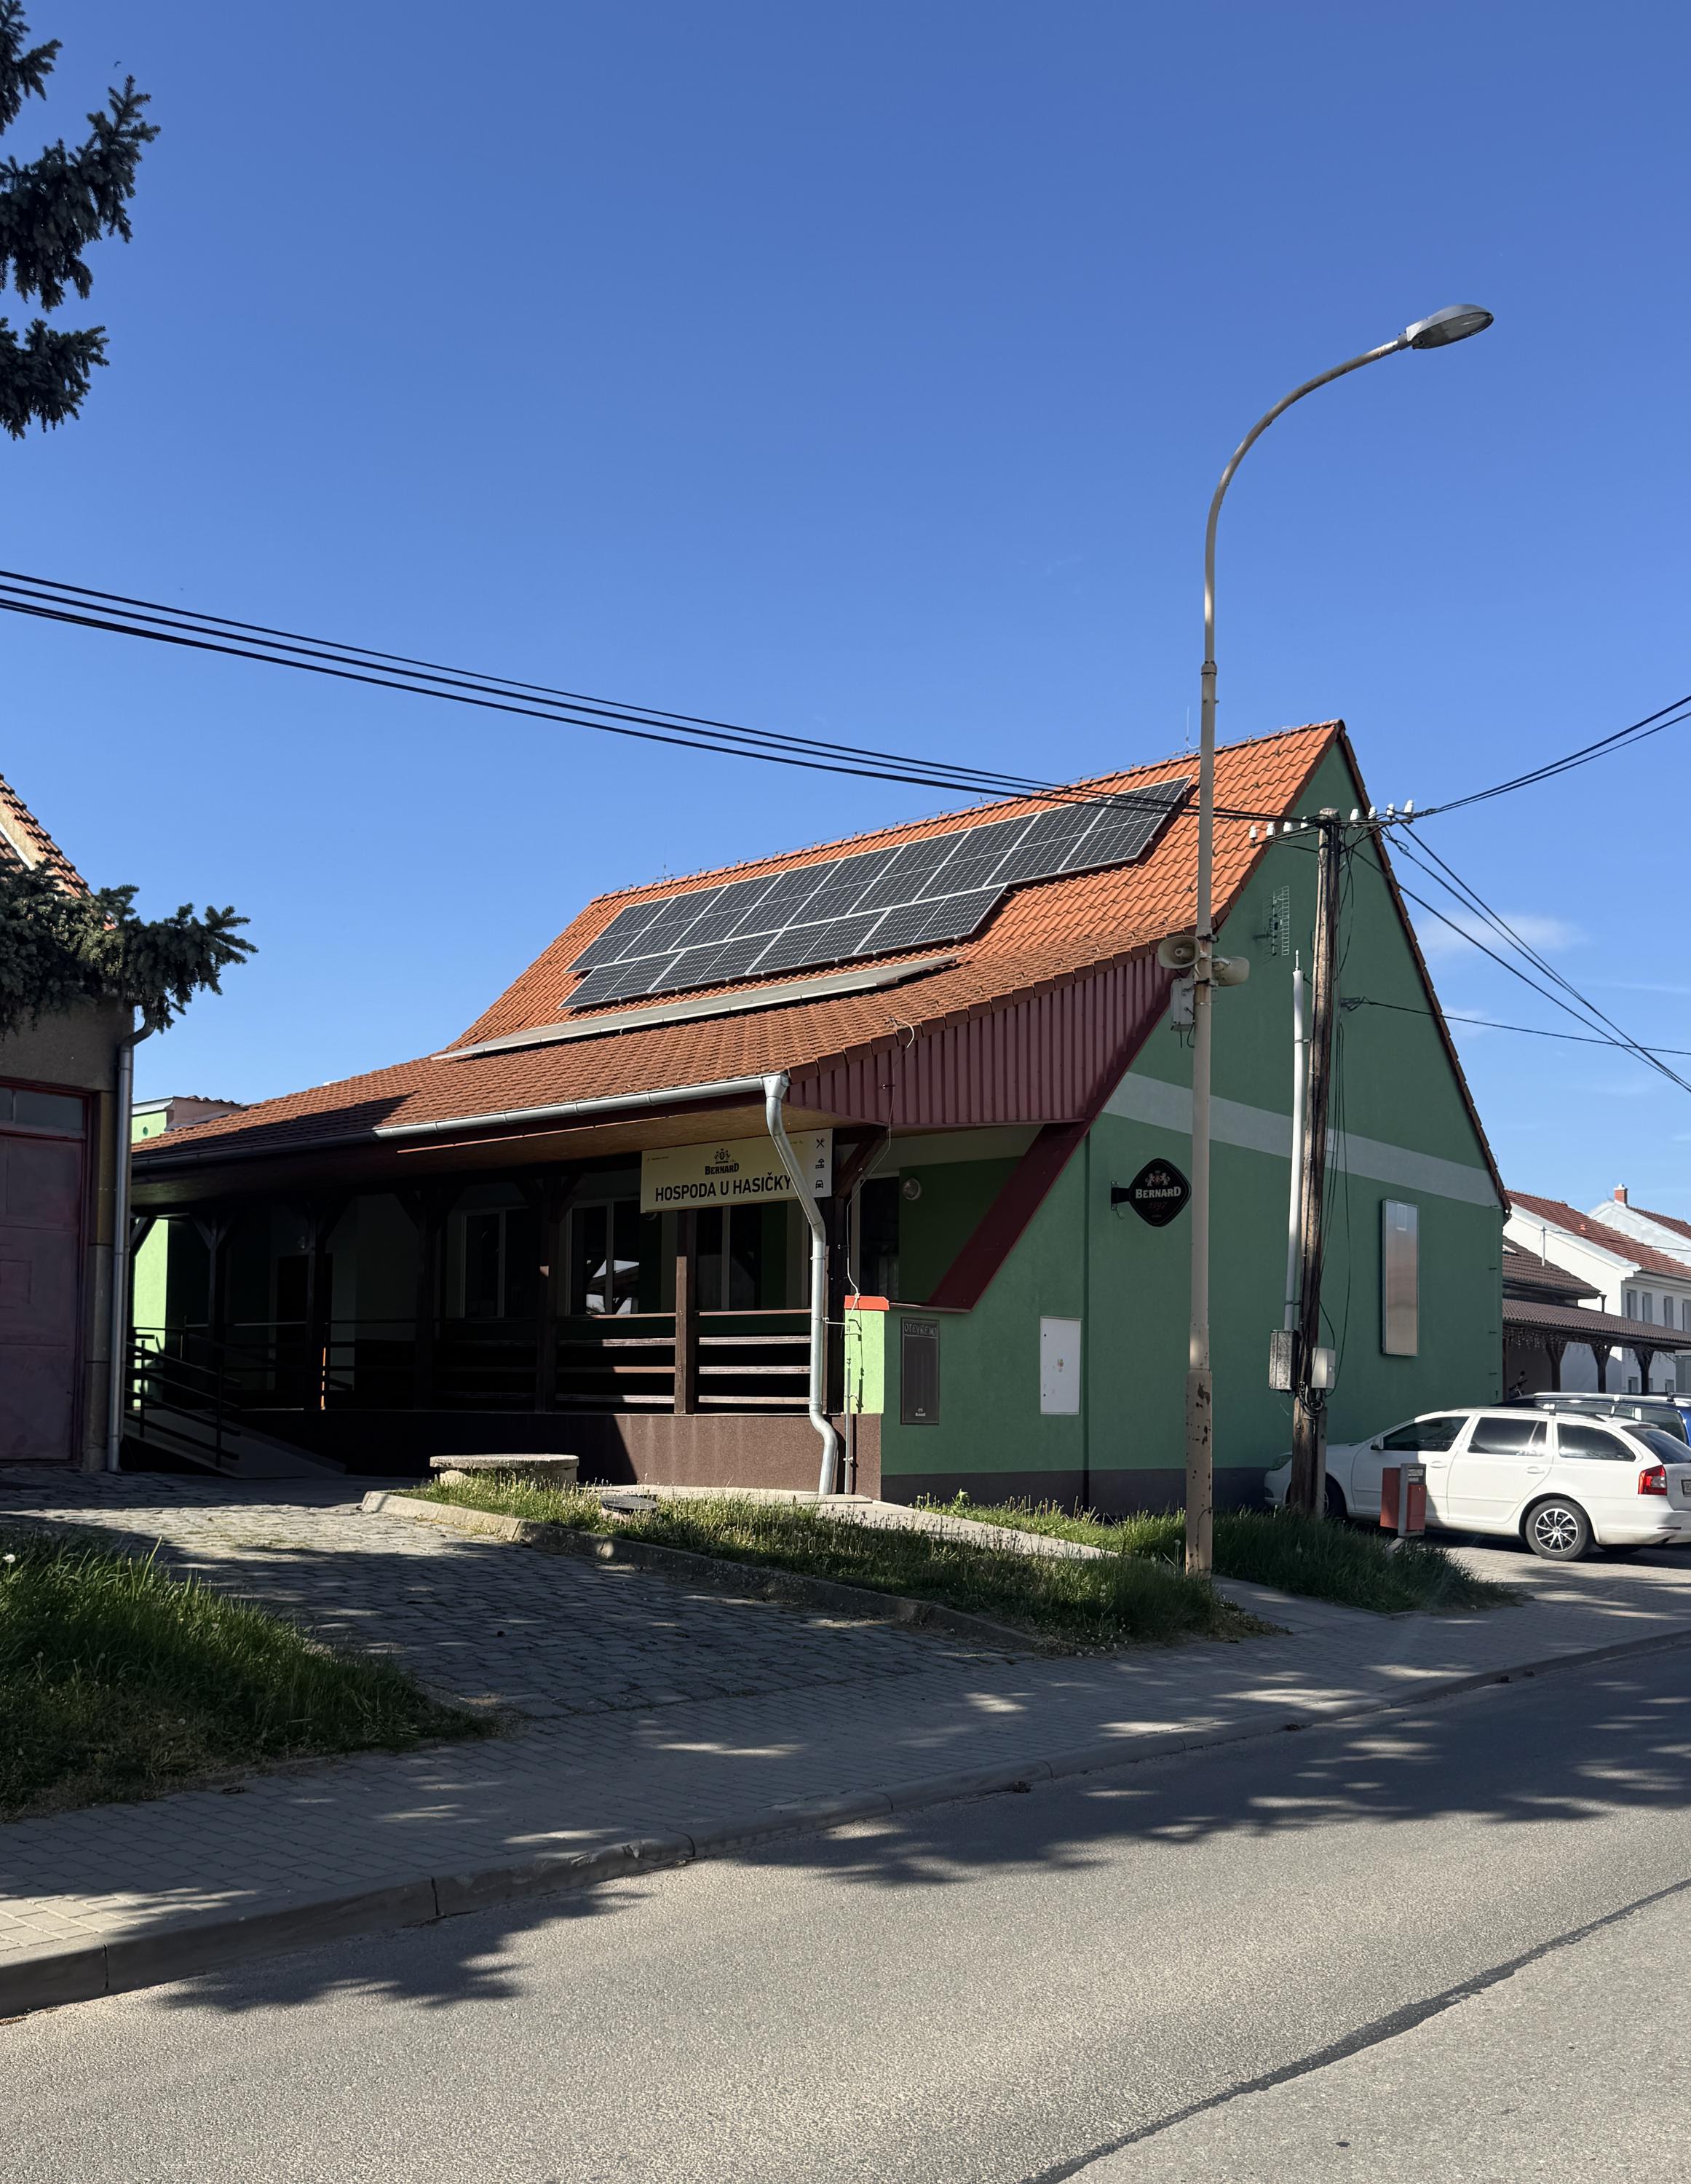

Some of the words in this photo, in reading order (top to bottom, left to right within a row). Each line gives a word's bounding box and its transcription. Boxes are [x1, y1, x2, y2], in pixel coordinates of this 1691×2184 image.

[705, 1163, 740, 1176] BERNARD
[655, 1182, 717, 1202] HOSPODA
[720, 1180, 729, 1196] U
[733, 1171, 791, 1195] HASIČKY
[1136, 1186, 1181, 1199] BERNARD
